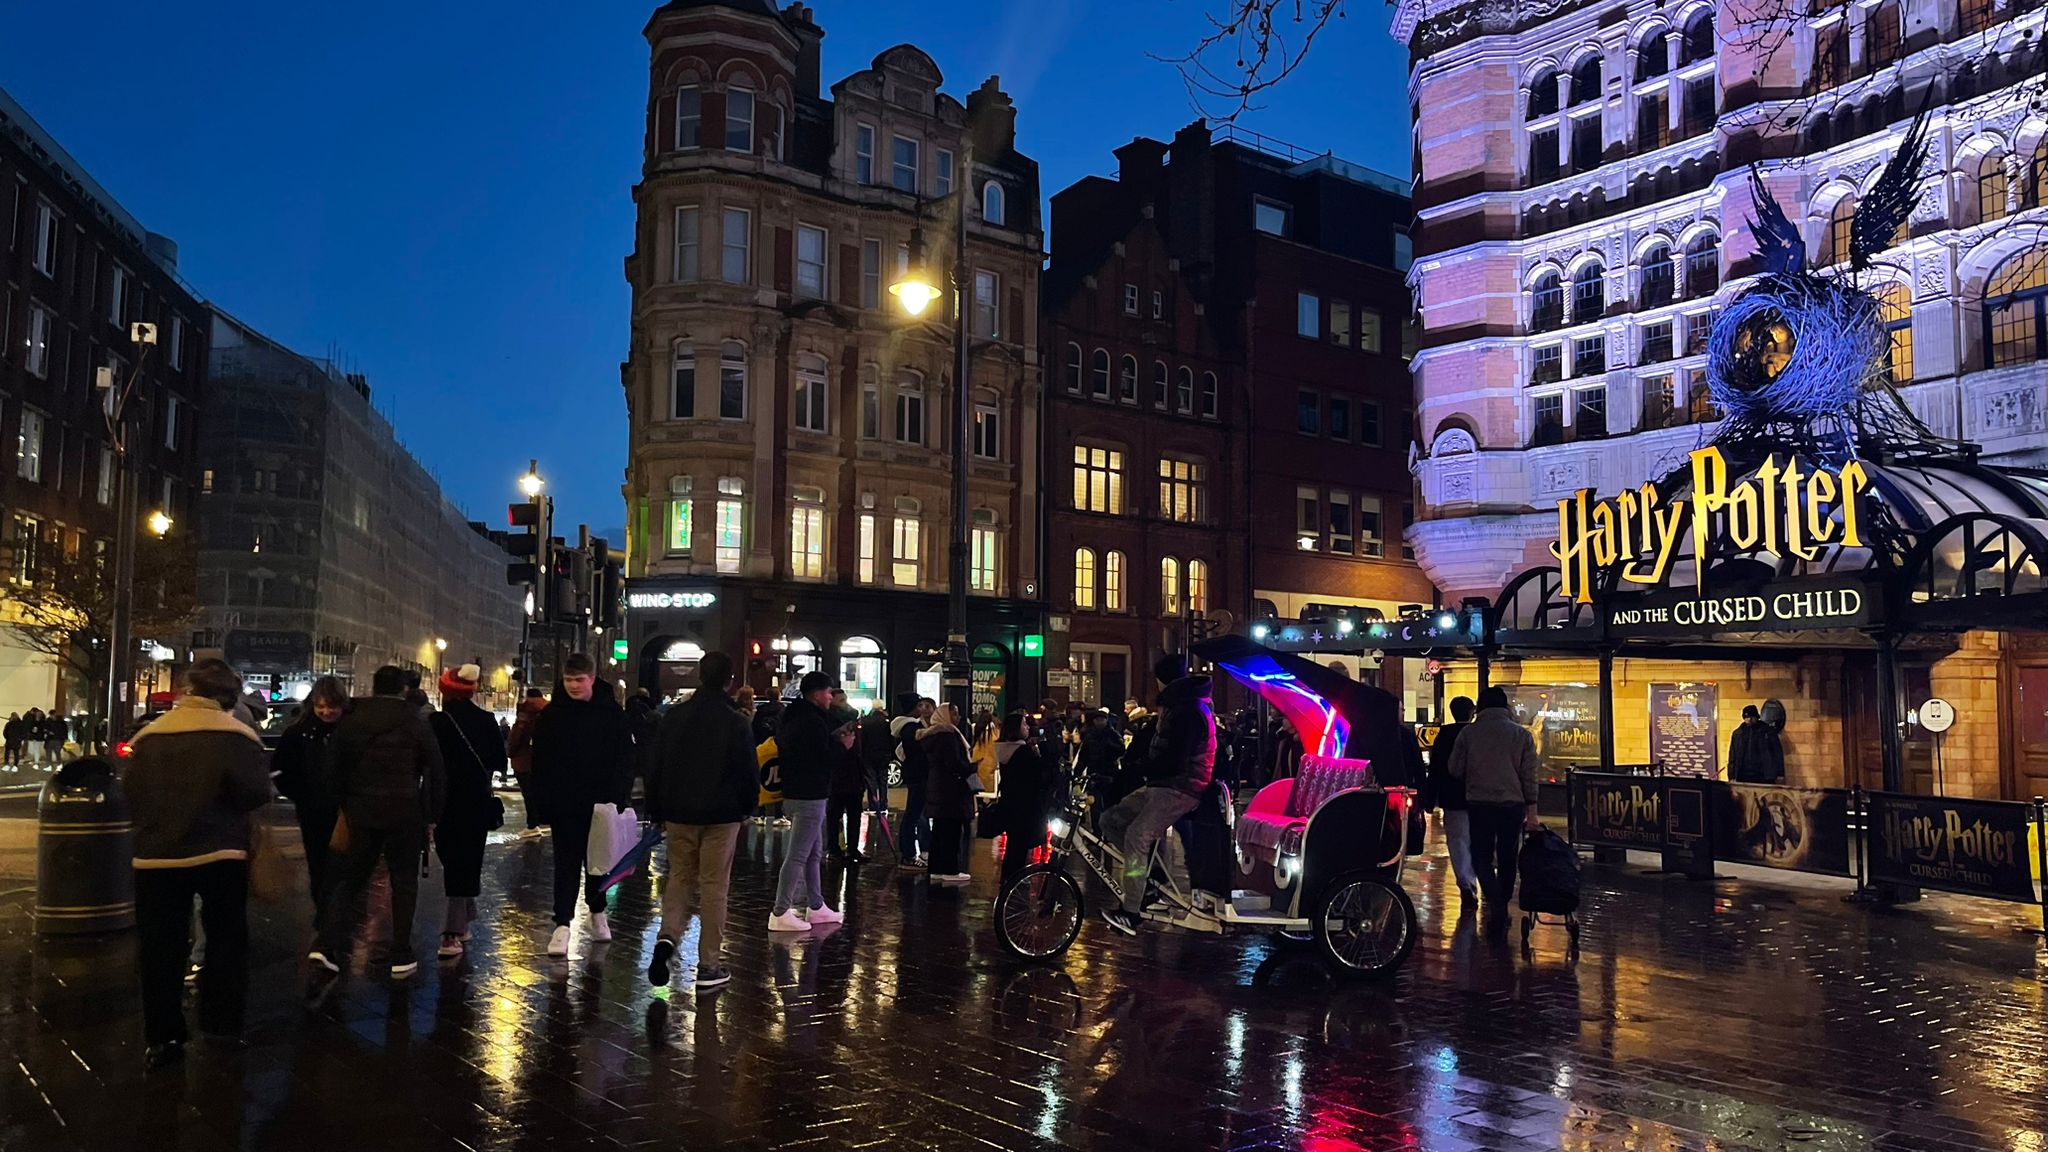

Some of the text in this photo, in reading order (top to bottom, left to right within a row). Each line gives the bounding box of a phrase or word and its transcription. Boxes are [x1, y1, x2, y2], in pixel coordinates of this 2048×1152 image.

[1549, 446, 1867, 604] Harry Potter
[1613, 589, 1861, 625] AND THE CURSED CHILD
[972, 670, 998, 680] DON'T
[1584, 787, 1630, 828] Harry
[1881, 809, 2016, 870] Harry Potter
[1910, 863, 1951, 880] CURSED
